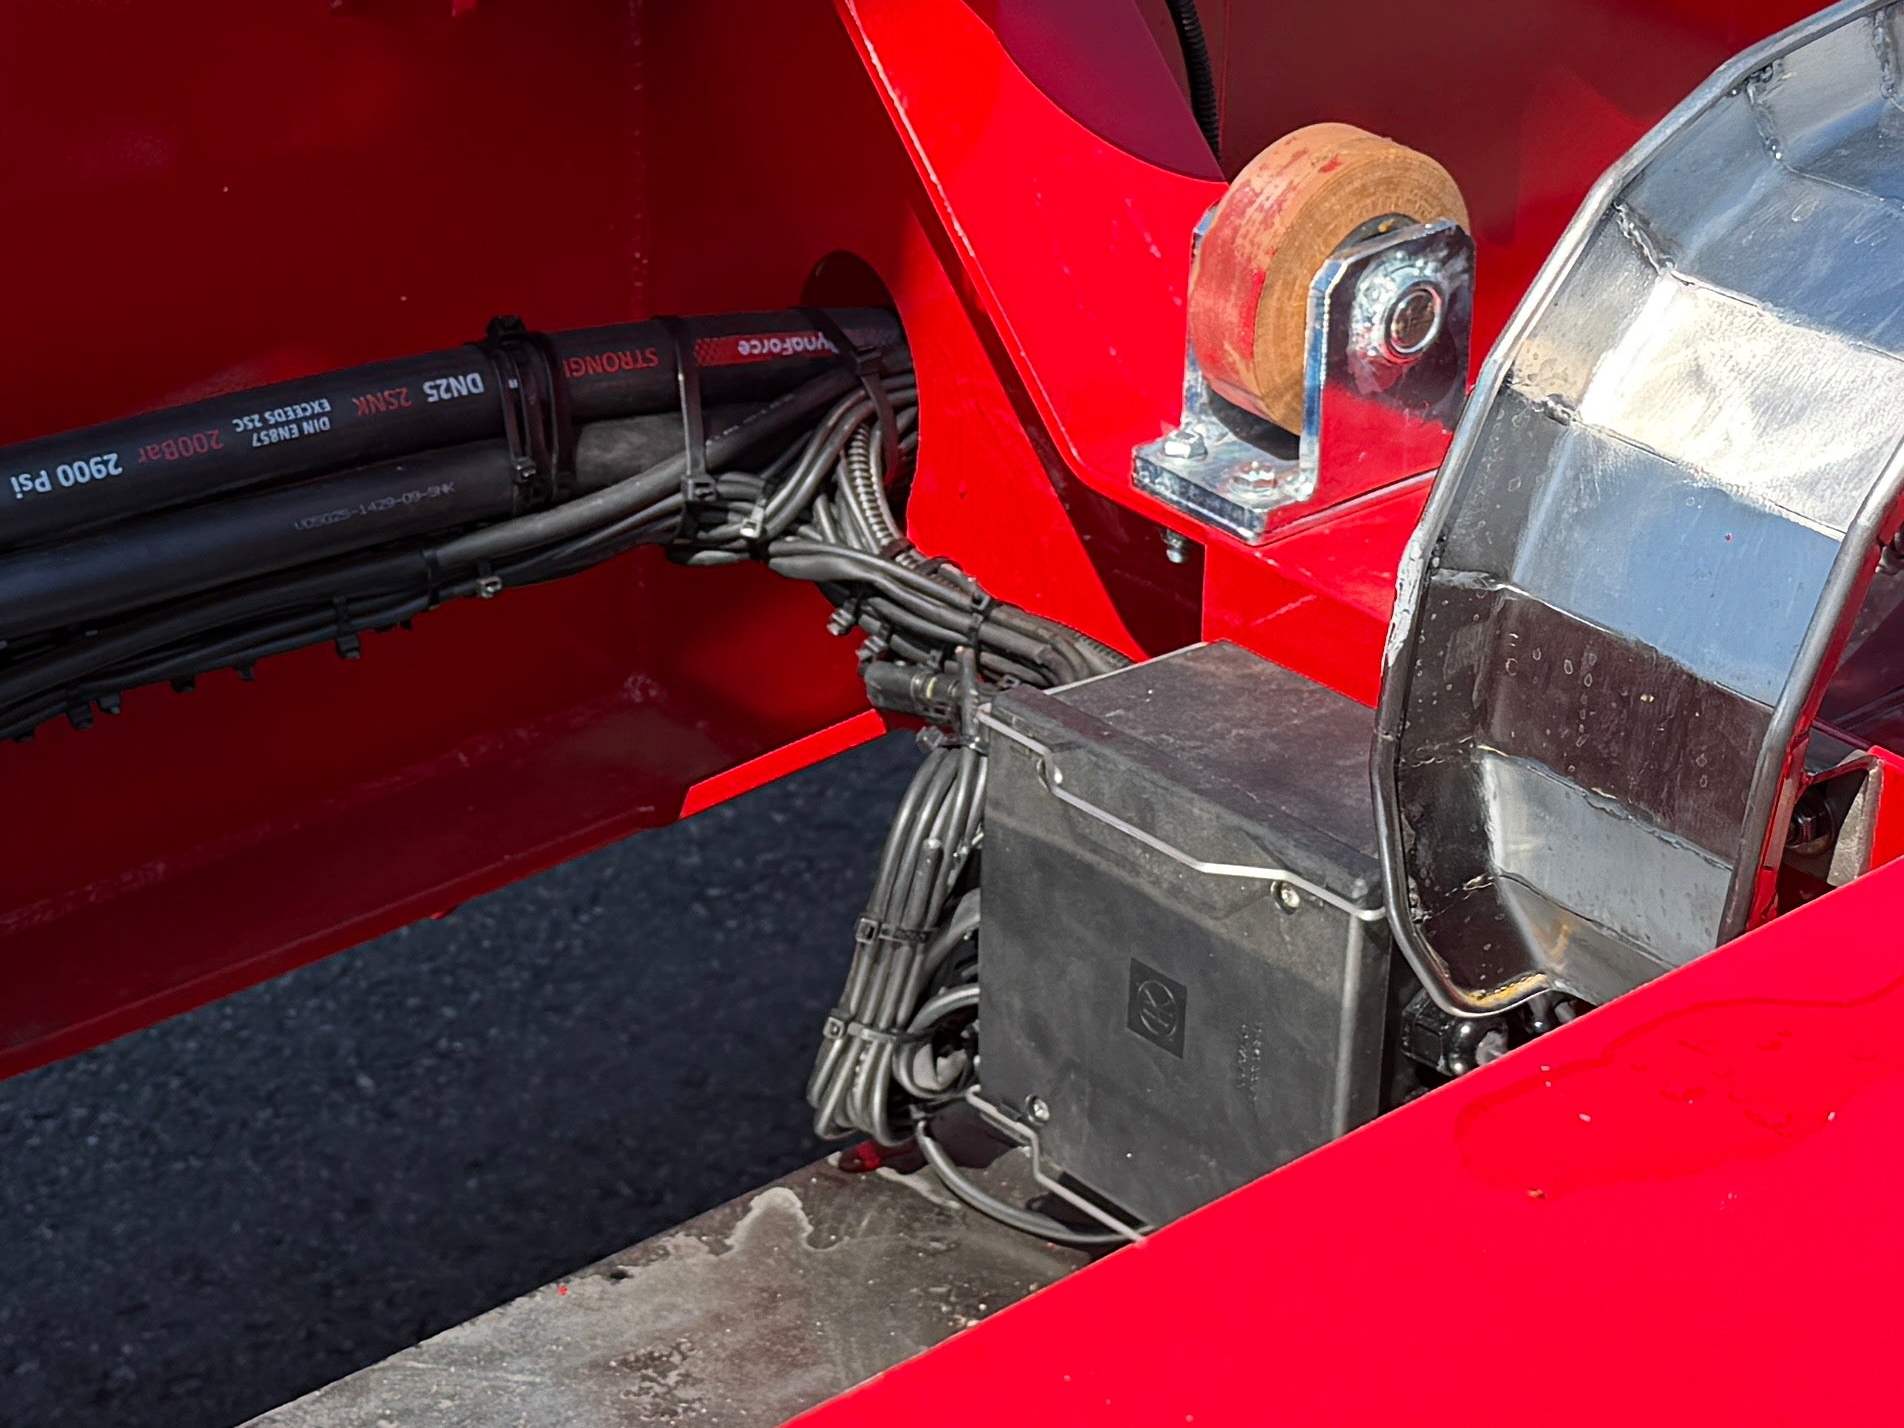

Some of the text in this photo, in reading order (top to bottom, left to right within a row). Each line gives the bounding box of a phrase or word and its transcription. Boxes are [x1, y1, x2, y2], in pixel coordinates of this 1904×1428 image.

[351, 372, 485, 417] DN25 2SNK
[232, 398, 332, 433] EXCEEDS 2SC
[251, 416, 331, 448] DIN EN857
[137, 429, 225, 465] 200Bar
[10, 470, 52, 499] Psi
[56, 453, 123, 487] 2900
